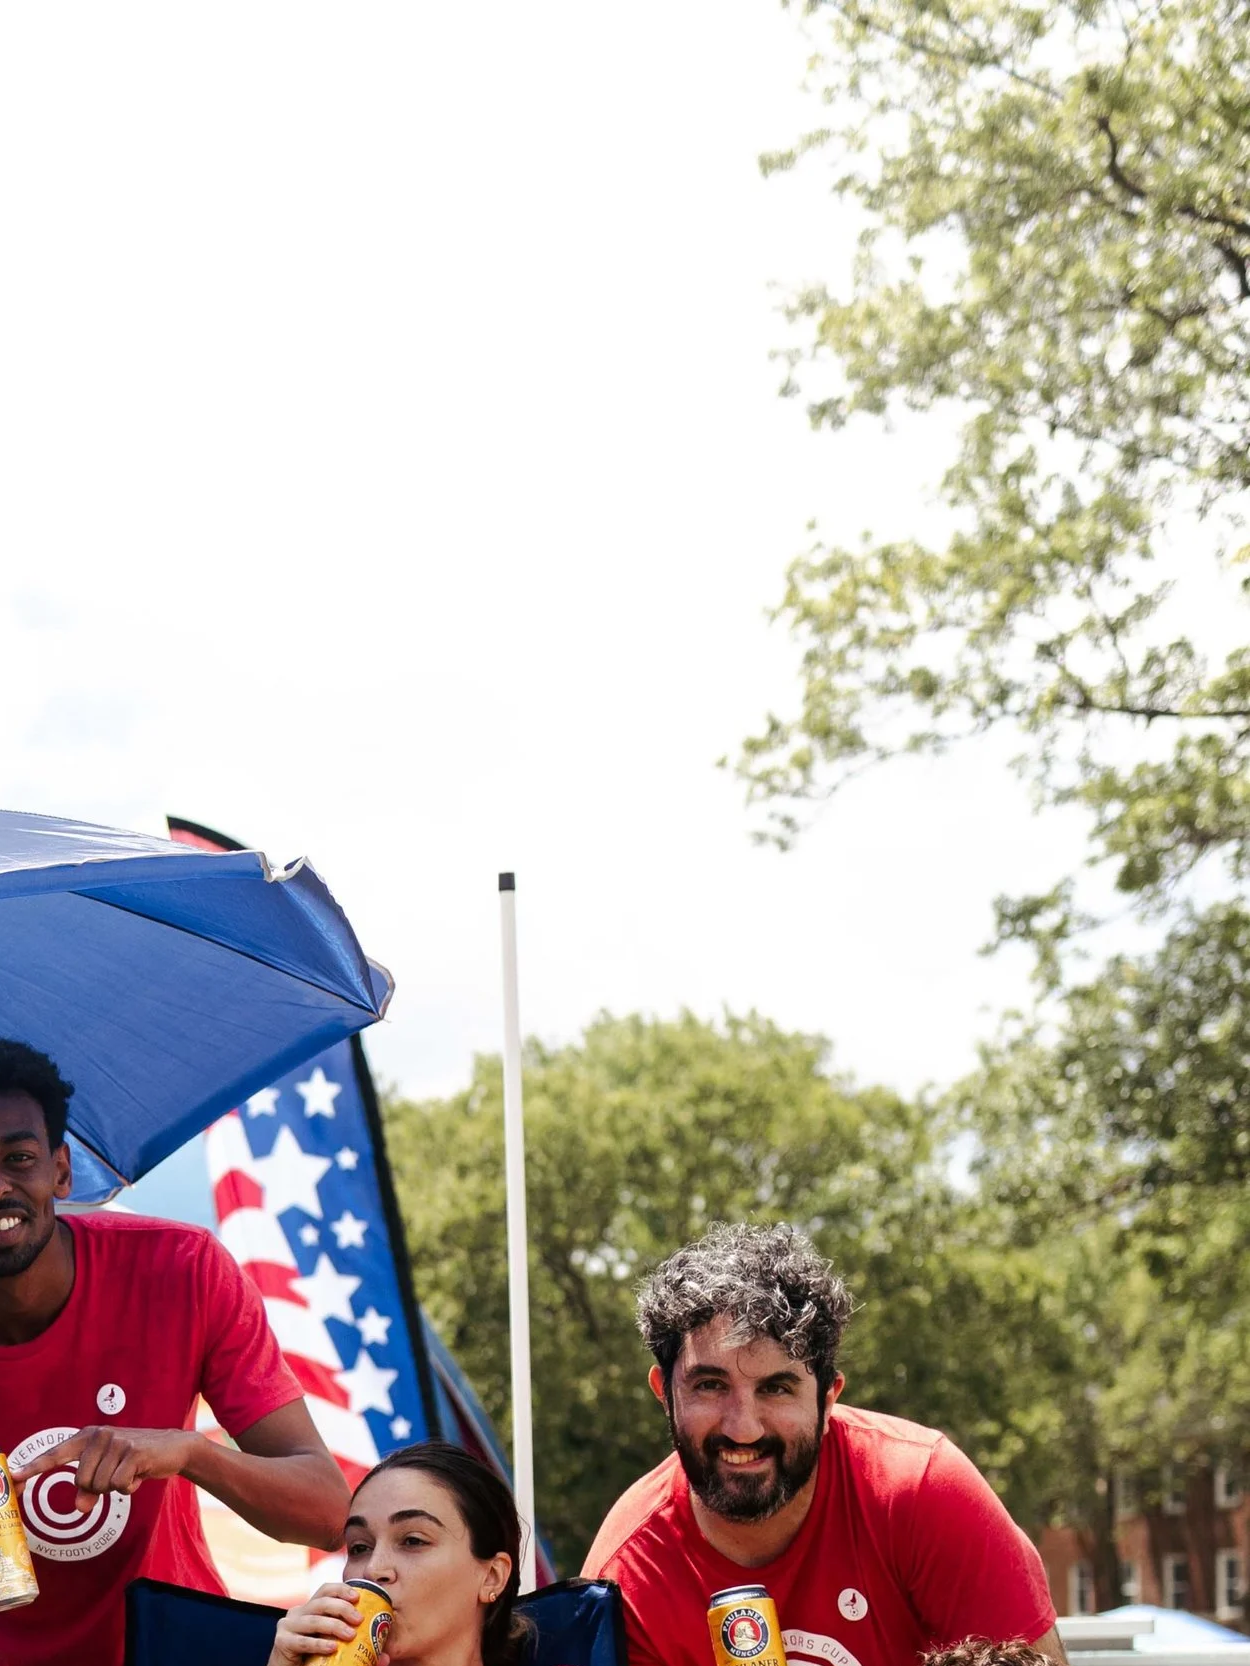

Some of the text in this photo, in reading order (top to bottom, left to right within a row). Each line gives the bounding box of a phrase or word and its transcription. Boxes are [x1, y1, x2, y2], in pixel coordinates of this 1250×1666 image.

[36, 1527, 117, 1557] NYC FOOTY 2026
[722, 1610, 764, 1632] PAULANER
[730, 1642, 766, 1657] MÜNCHEN
[821, 1642, 849, 1665] CUP
